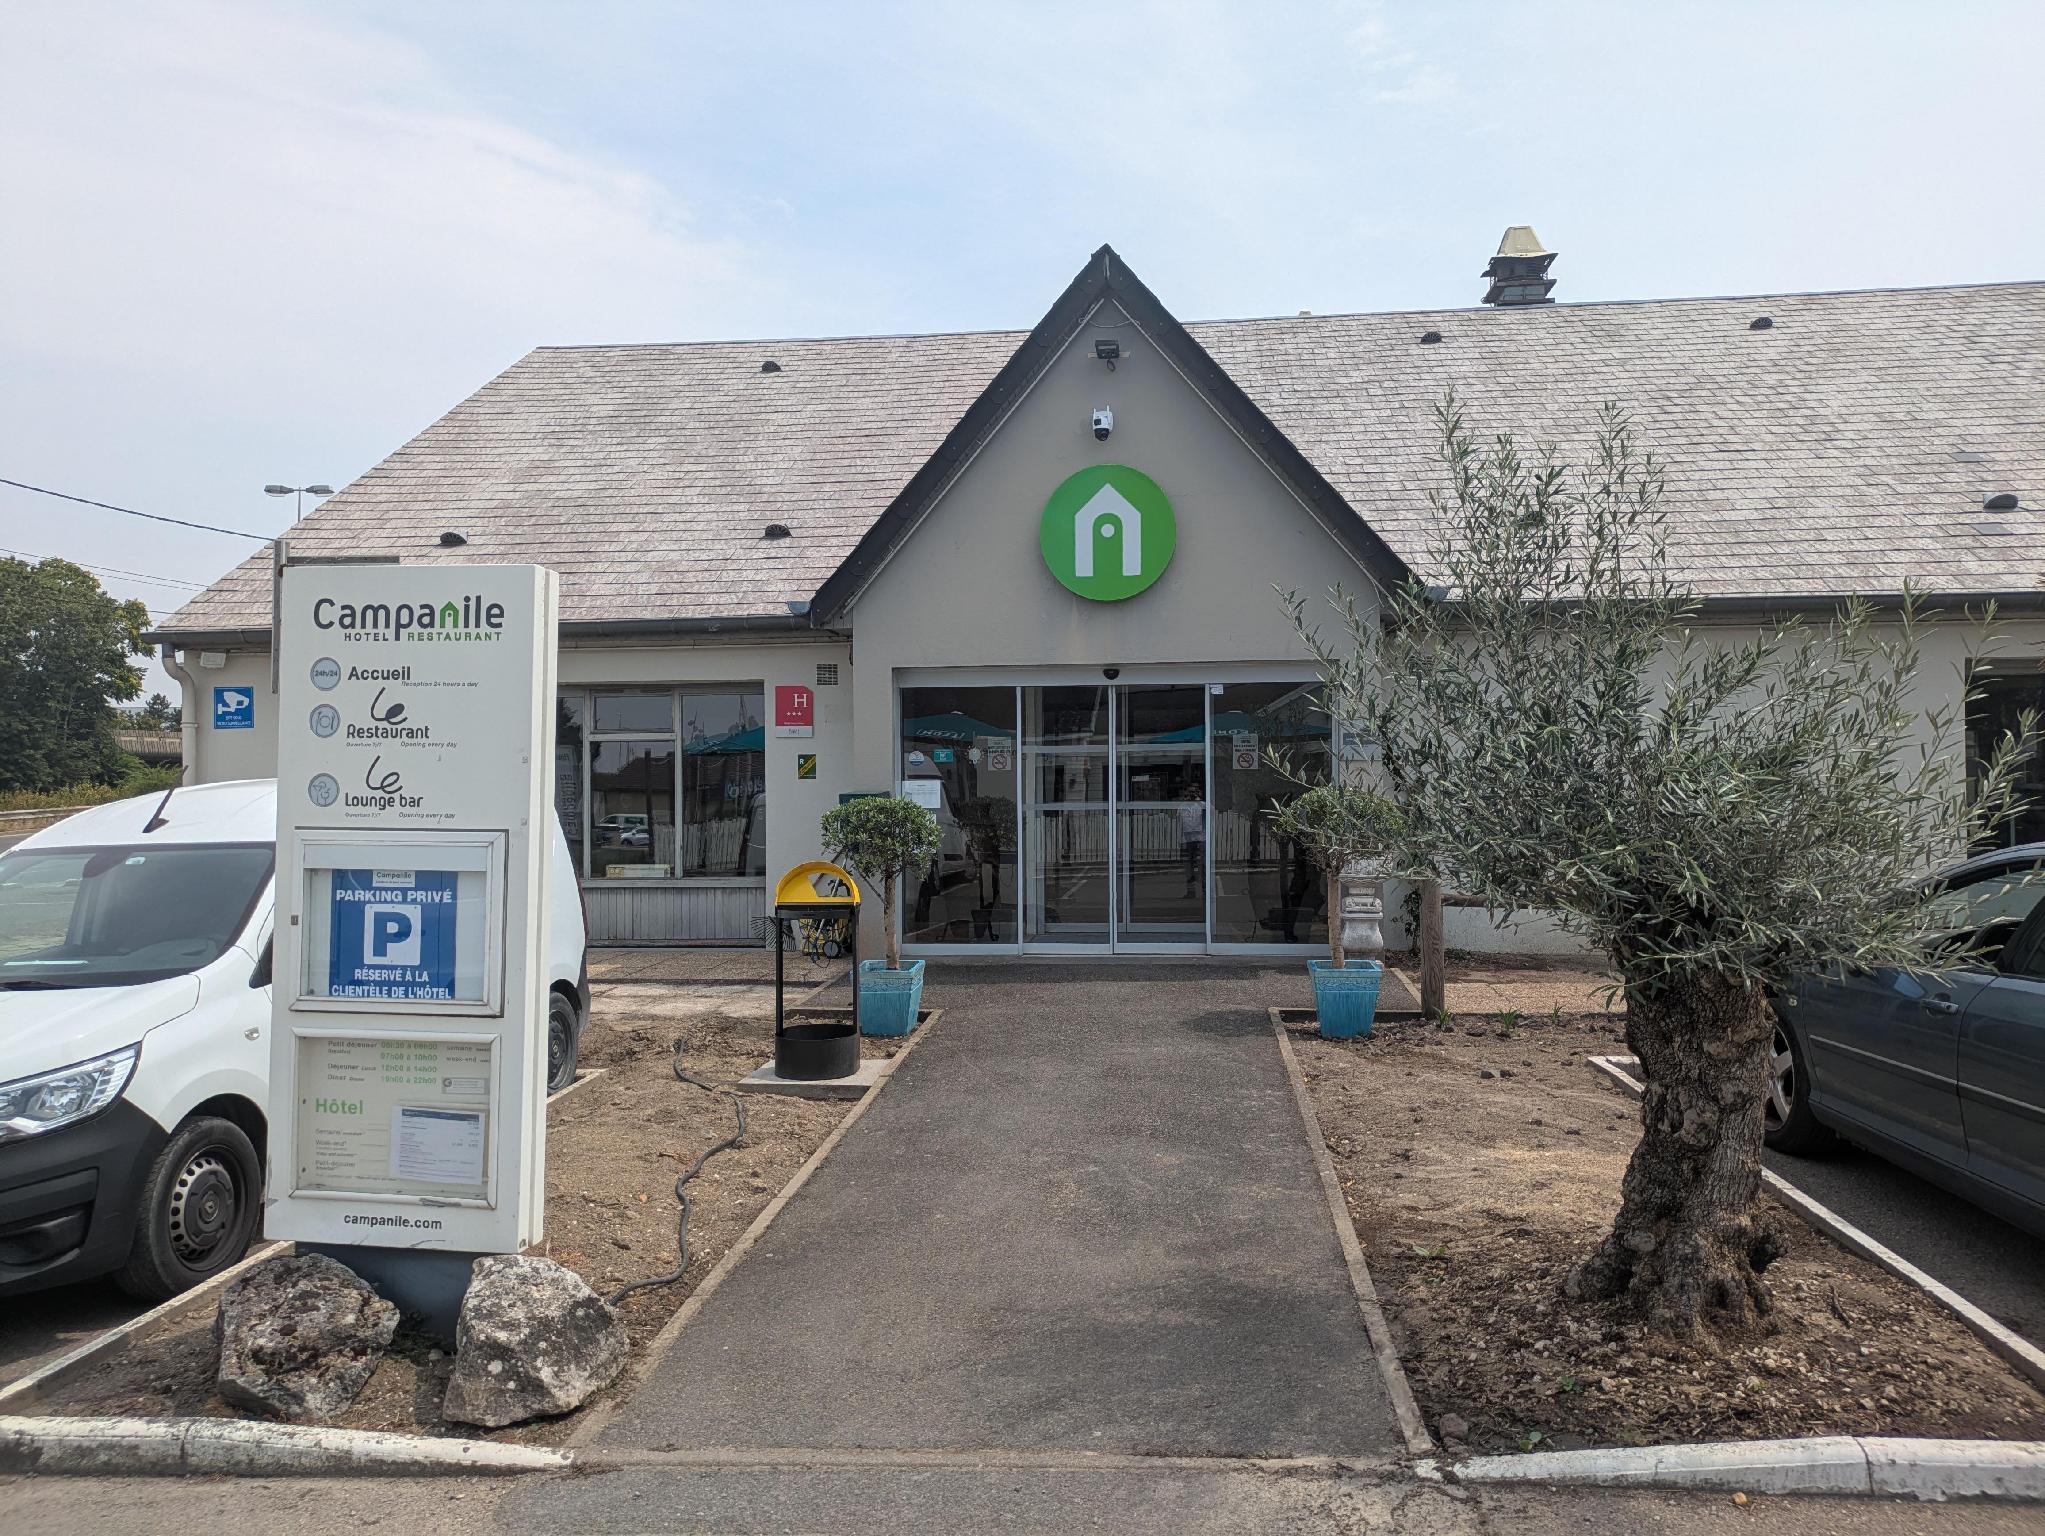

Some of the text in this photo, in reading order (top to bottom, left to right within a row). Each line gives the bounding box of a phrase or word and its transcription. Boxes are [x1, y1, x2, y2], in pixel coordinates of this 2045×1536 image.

[313, 595, 505, 641] Campanile
[344, 632, 502, 642] HOTEL RESTAURANT
[347, 666, 411, 680] Accueil
[793, 693, 808, 708] H
[346, 723, 430, 739] Restaurant
[345, 792, 424, 810] Lounge bar
[443, 812, 456, 820] day
[336, 888, 453, 903] PARKING PRIVÉ
[372, 911, 412, 957] P
[354, 966, 429, 982] RÉSERVÉ À LA
[331, 983, 452, 999] CLIENTÈLE DE L'HÔTEL
[315, 1097, 364, 1115] Hôtel
[343, 1214, 442, 1230] campanile.com
